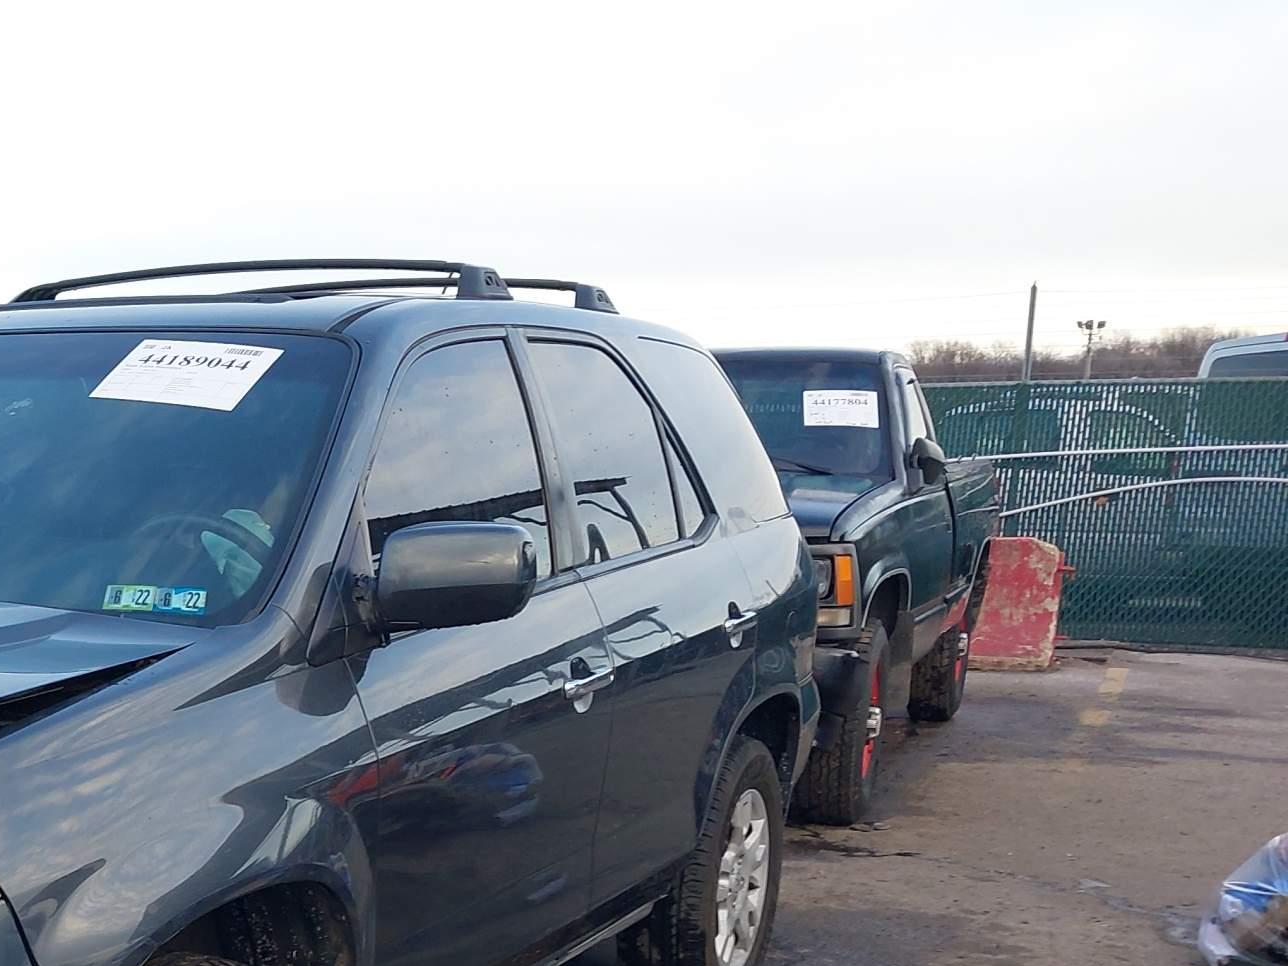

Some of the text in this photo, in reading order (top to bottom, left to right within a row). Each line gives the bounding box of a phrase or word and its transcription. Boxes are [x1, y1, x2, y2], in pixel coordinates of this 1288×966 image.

[138, 353, 251, 371] 44189044
[135, 589, 151, 606] 22
[185, 592, 201, 609] 22
